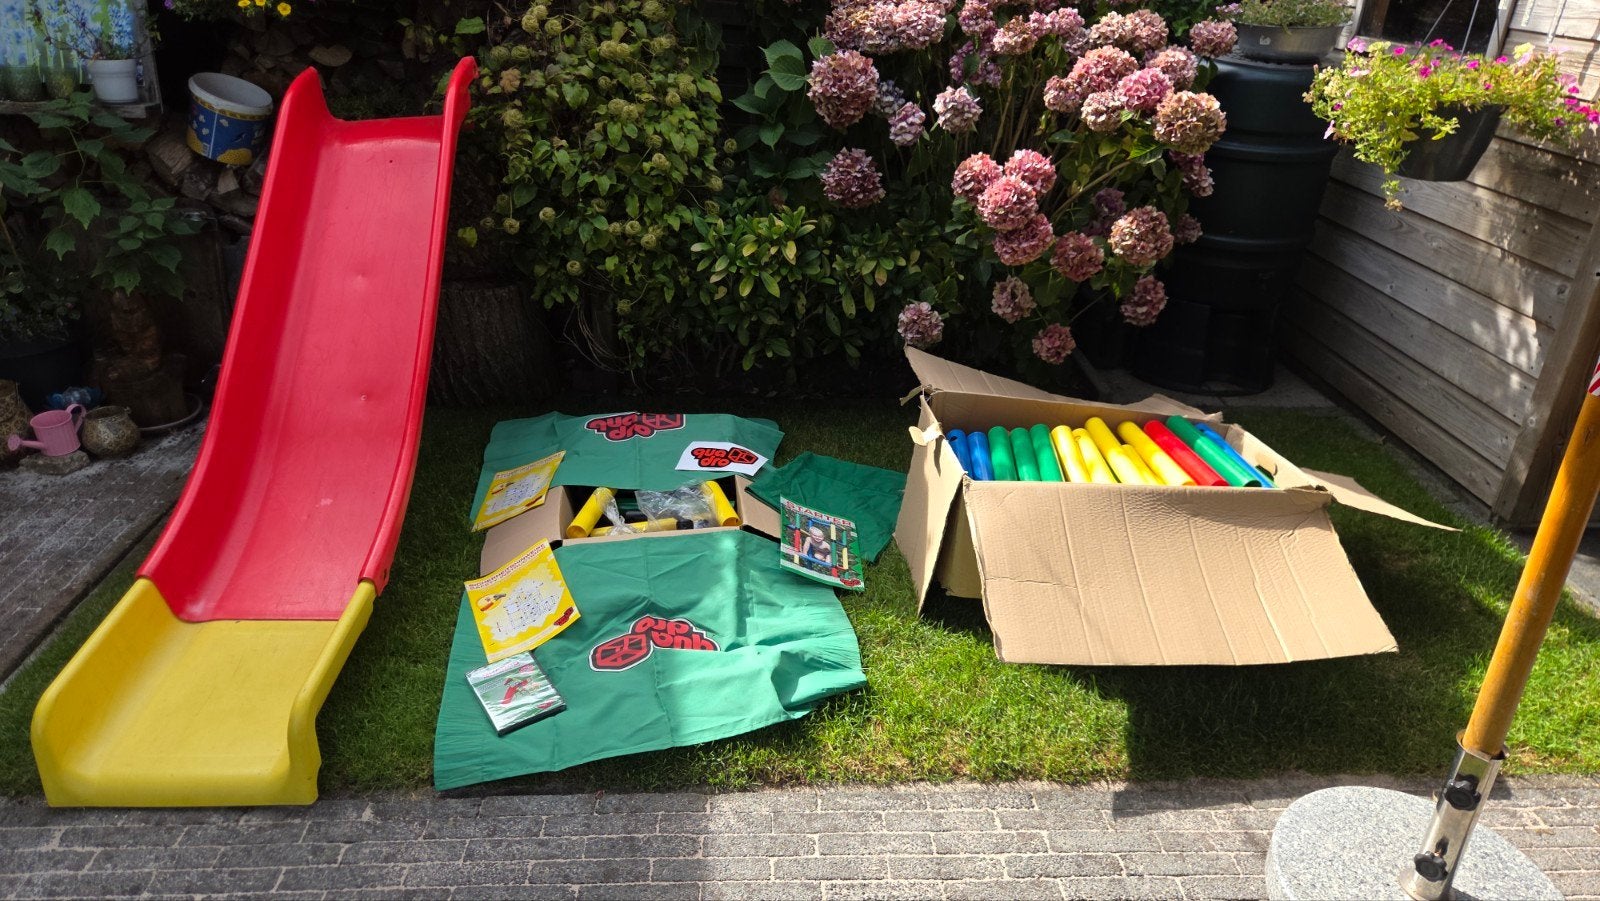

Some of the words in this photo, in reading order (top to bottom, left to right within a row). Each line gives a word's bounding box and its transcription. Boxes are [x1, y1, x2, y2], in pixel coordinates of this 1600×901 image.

[609, 424, 652, 440] dro
[692, 448, 727, 459] qua
[700, 456, 730, 467] dro
[786, 501, 852, 527] STARTER
[635, 617, 690, 635] dro
